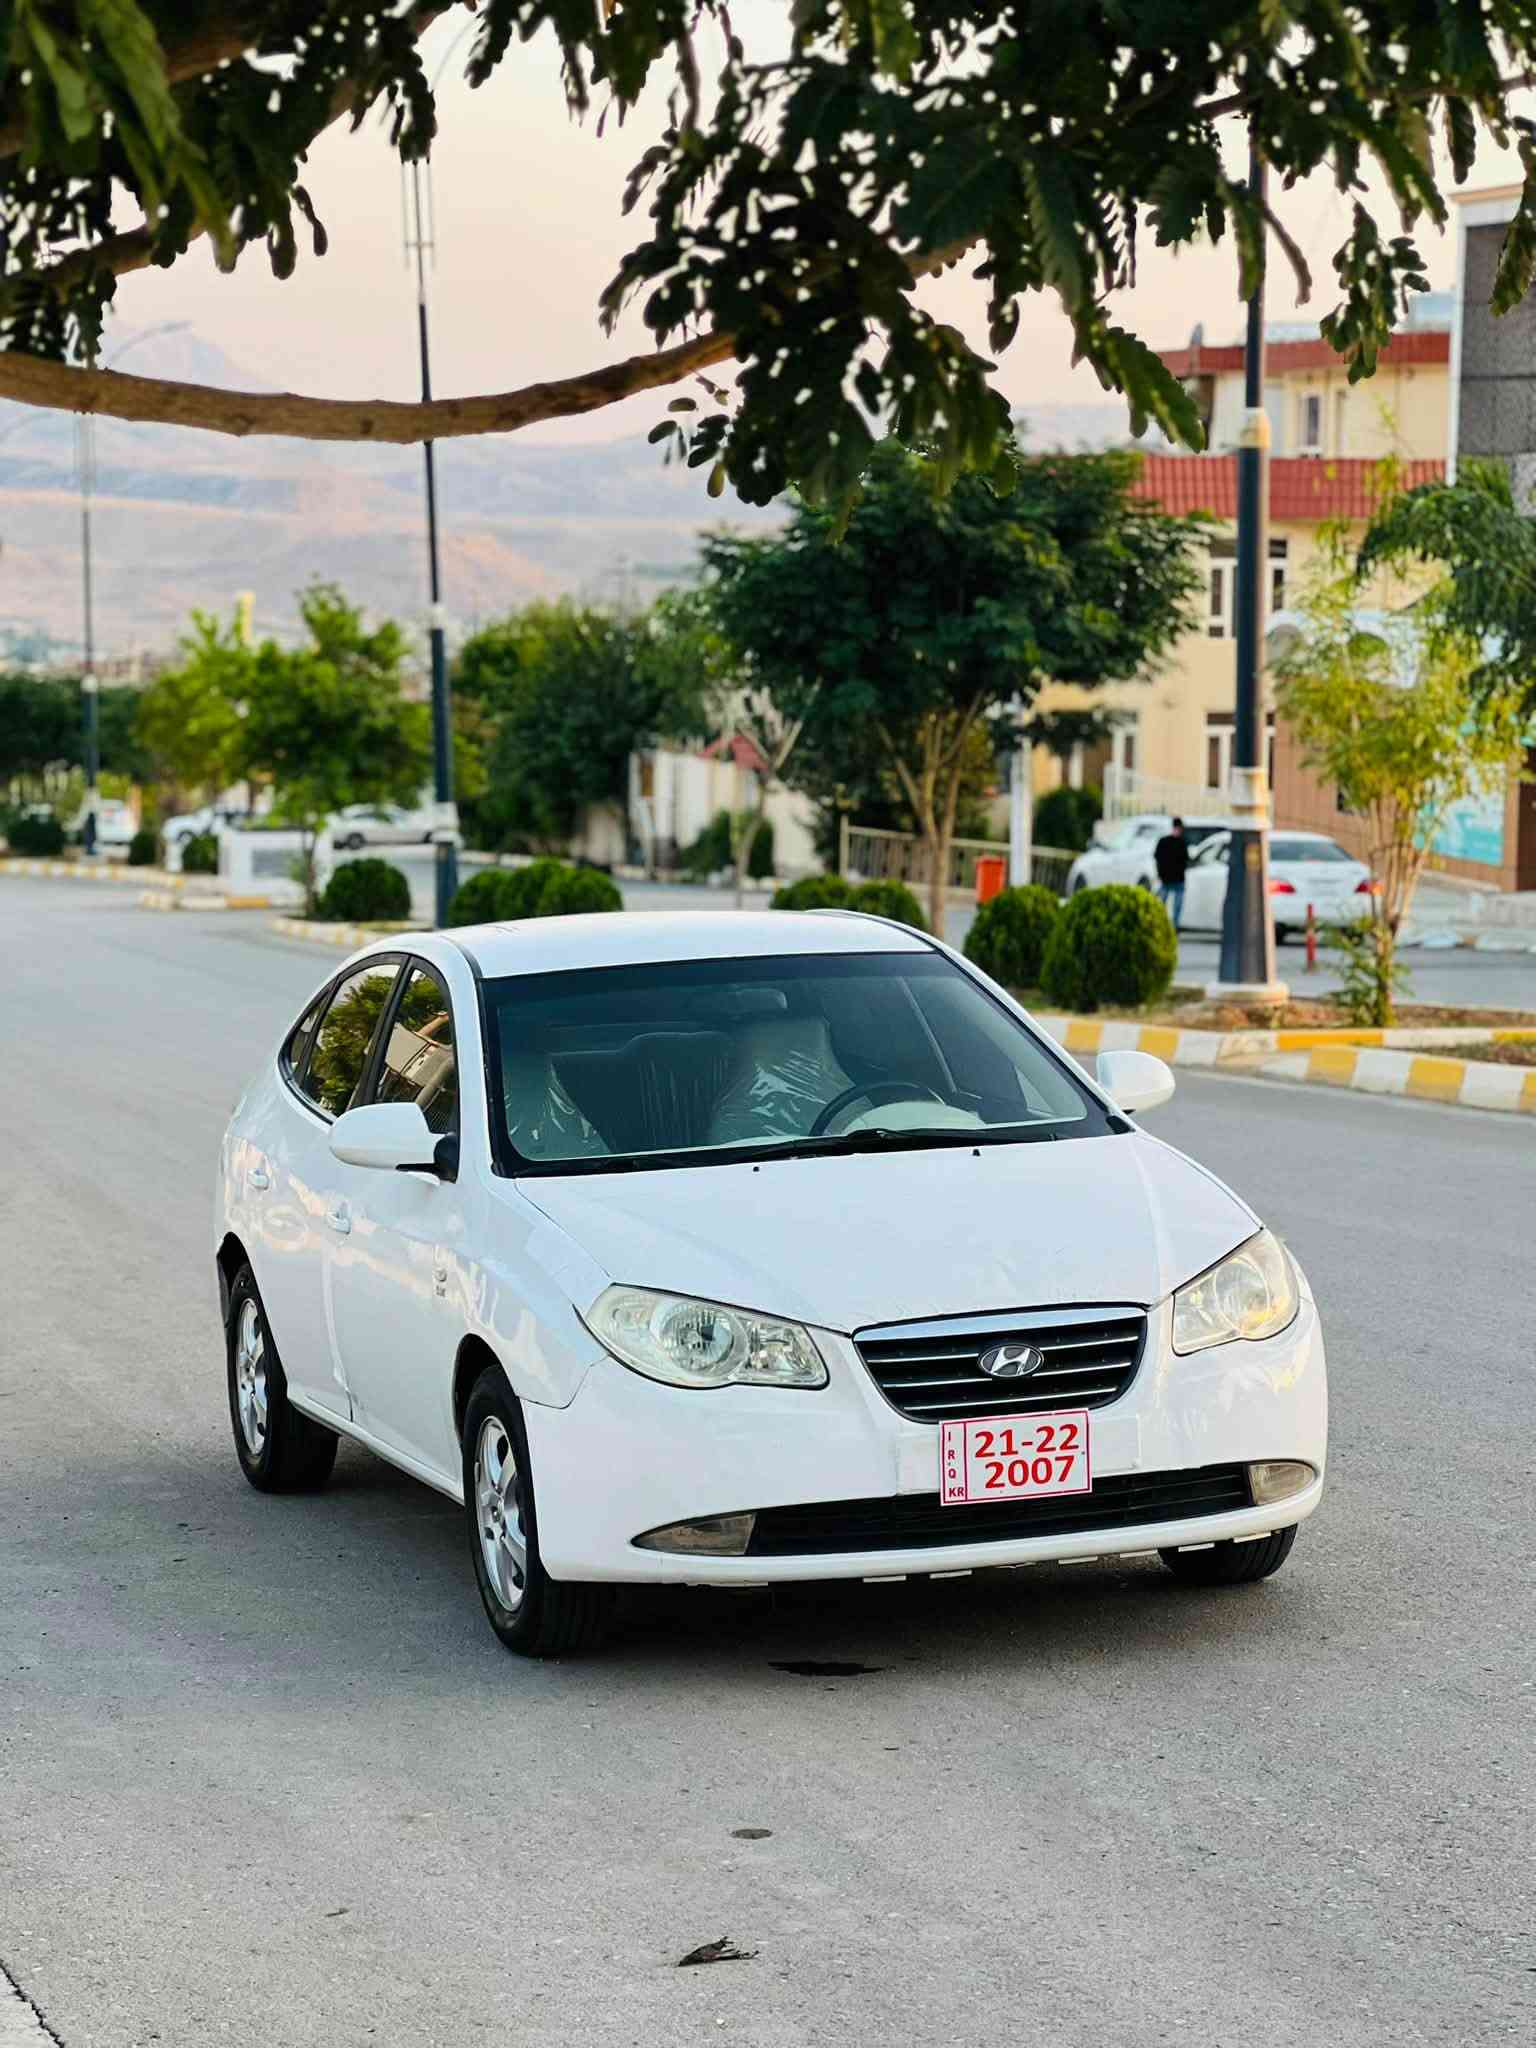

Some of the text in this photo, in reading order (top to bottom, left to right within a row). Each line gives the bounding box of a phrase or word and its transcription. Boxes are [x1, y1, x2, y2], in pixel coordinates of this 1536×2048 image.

[975, 1423, 1079, 1458] 21-22
[985, 1455, 1075, 1489] 2007
[948, 1486, 964, 1497] KR
